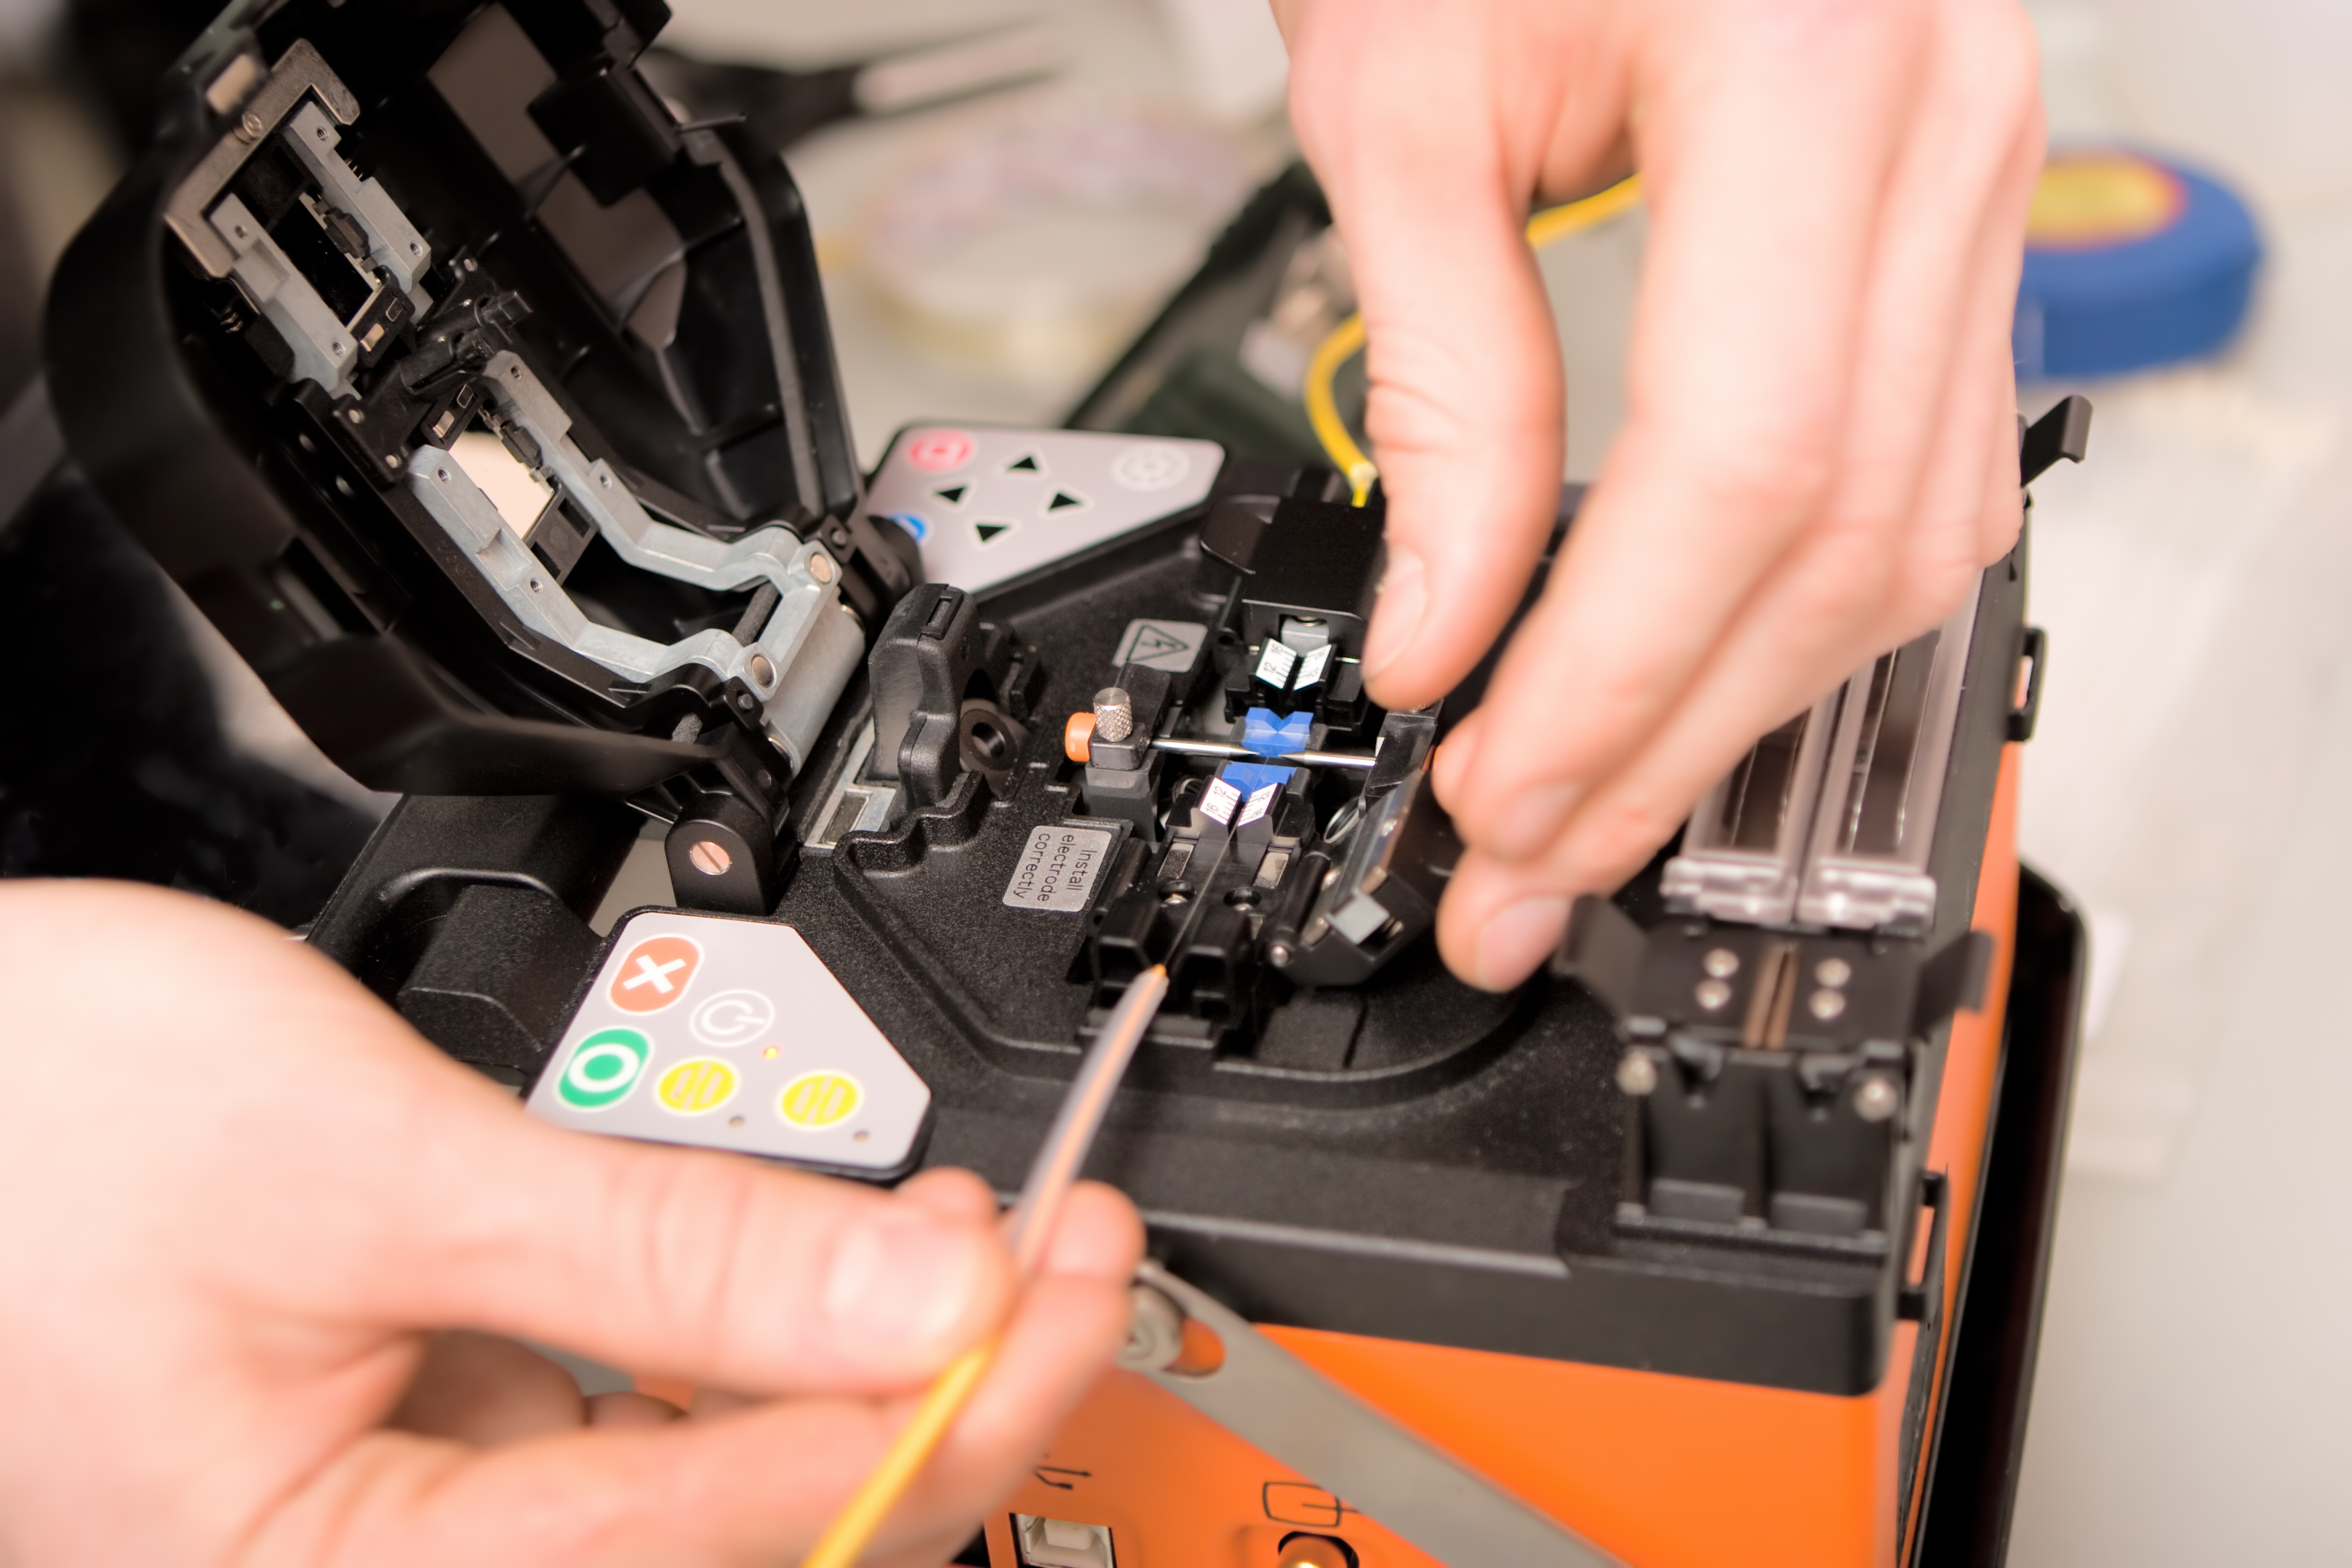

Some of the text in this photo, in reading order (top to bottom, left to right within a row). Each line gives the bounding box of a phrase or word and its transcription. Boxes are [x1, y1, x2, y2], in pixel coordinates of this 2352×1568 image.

[1263, 661, 1277, 674] 12
[1213, 785, 1227, 798] 12
[1206, 802, 1220, 815] 16
[1013, 833, 1050, 899] correctly
[1037, 834, 1077, 902] electrode
[1066, 849, 1098, 891] Install
